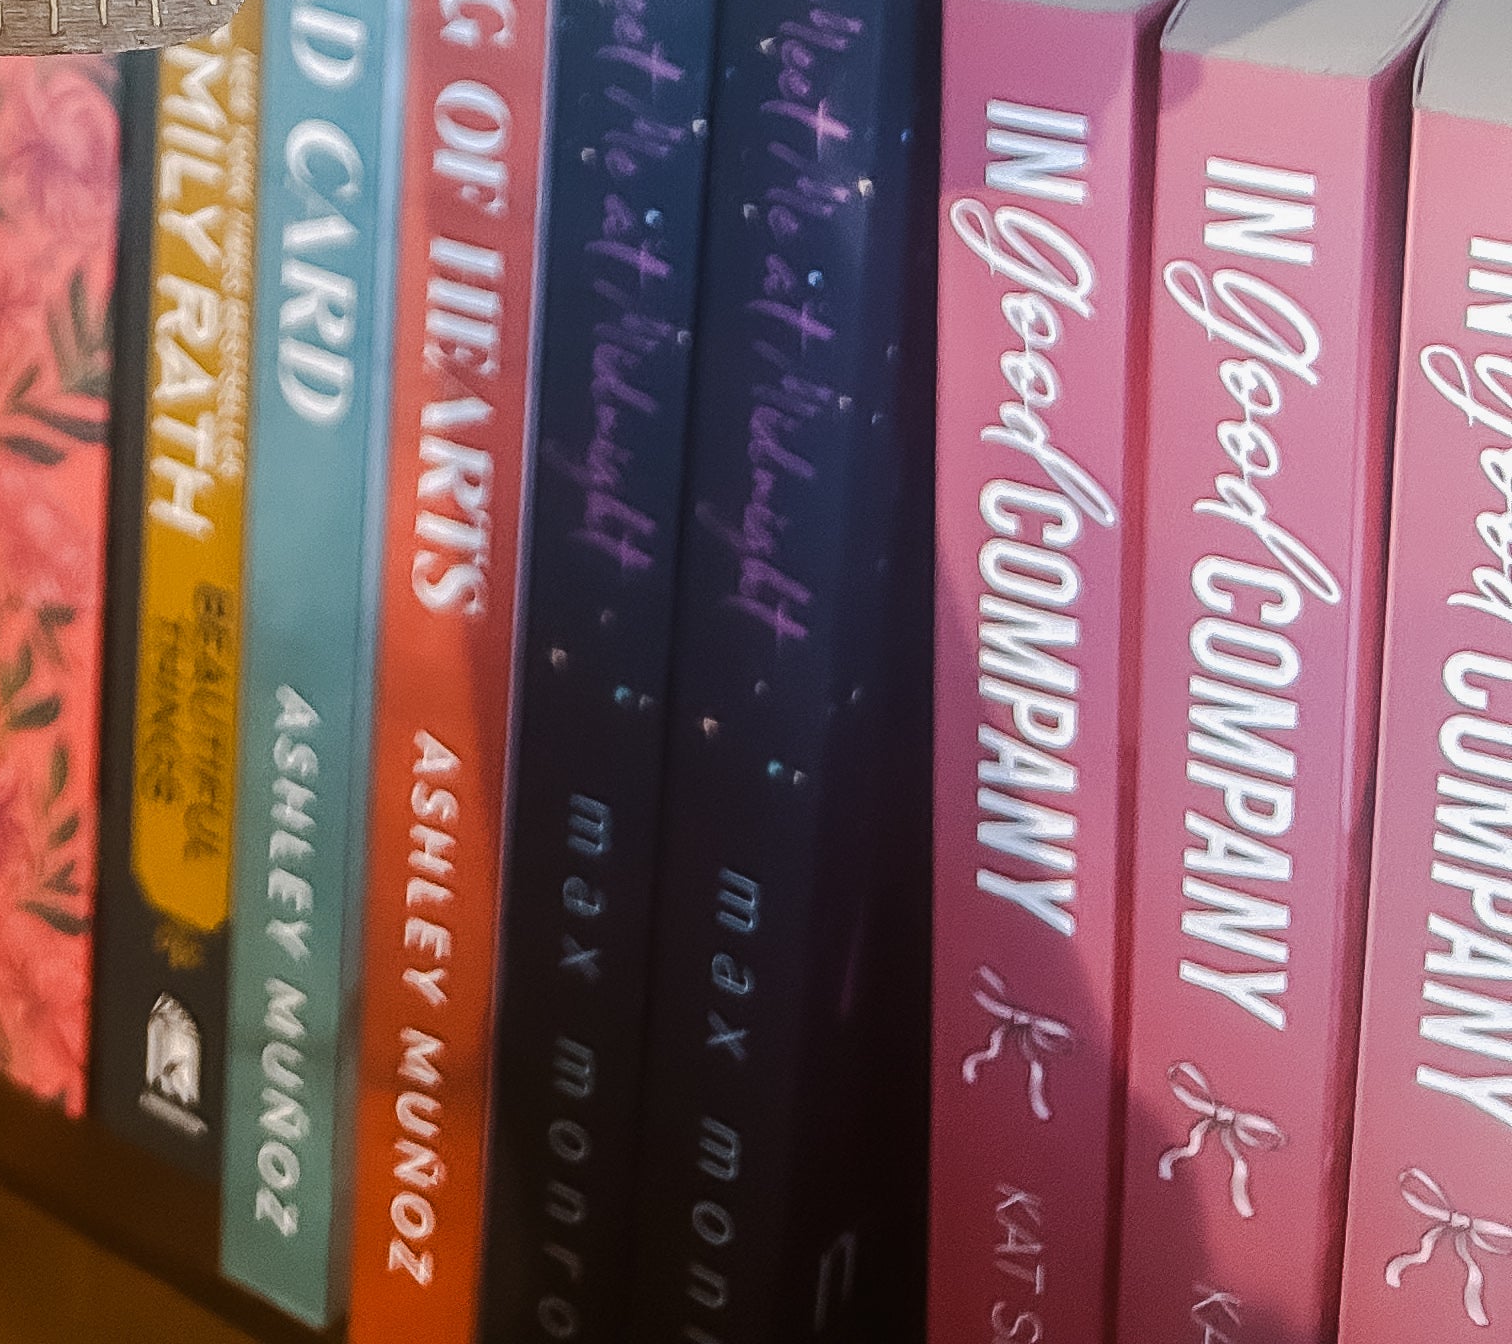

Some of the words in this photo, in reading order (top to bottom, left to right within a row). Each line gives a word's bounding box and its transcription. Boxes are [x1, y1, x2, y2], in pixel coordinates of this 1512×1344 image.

[279, 120, 367, 428] CARD
[432, 78, 511, 215] OF
[984, 98, 1088, 204] IN
[1202, 155, 1317, 265] IN
[149, 274, 222, 540] RATH
[411, 236, 506, 616] HEARTS
[949, 197, 1116, 527] Good
[1163, 259, 1342, 603] Good
[266, 683, 324, 965] ASHLEY
[977, 477, 1083, 937] COMPANY
[1179, 554, 1303, 1031] COMPANY
[404, 728, 462, 1006] ASHLEY
[557, 793, 613, 981] max
[706, 866, 762, 1061] max
[254, 977, 312, 1238] MUÑOZ
[389, 1026, 446, 1287] MUÑOZ
[995, 1182, 1045, 1296] KAT
